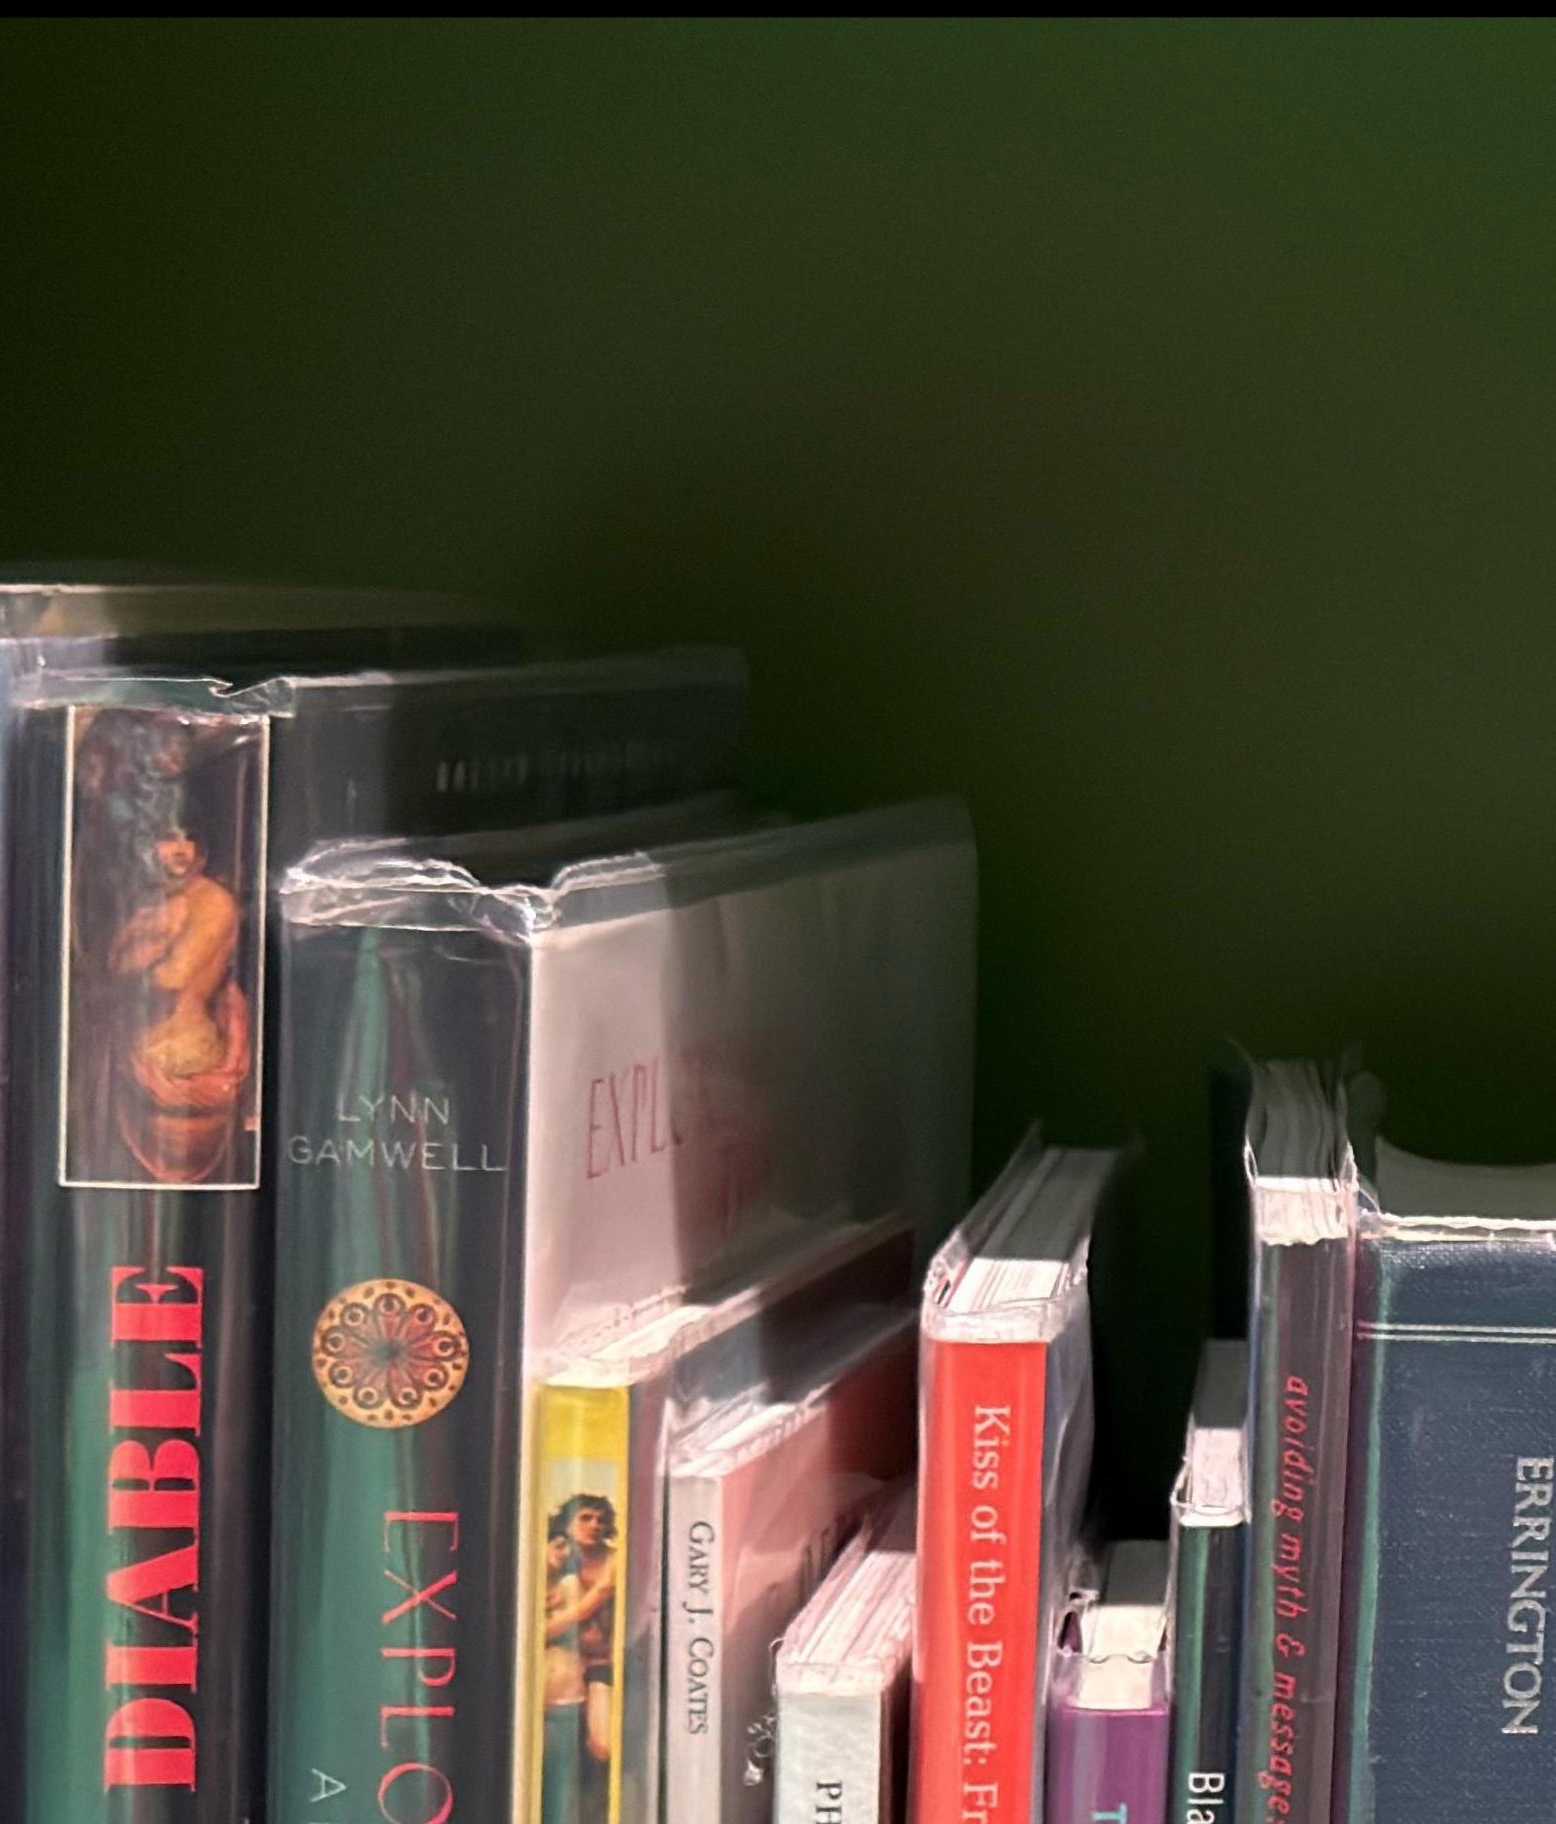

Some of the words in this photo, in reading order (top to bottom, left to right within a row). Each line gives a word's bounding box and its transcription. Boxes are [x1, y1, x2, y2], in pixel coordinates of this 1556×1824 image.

[288, 1138, 506, 1171] GAMWELL
[338, 1095, 449, 1124] LYNN
[106, 1266, 203, 1791] DIABLE
[686, 1522, 713, 1603] GARY
[1501, 1458, 1553, 1736] ERRINGTON
[686, 1636, 714, 1736] COATES
